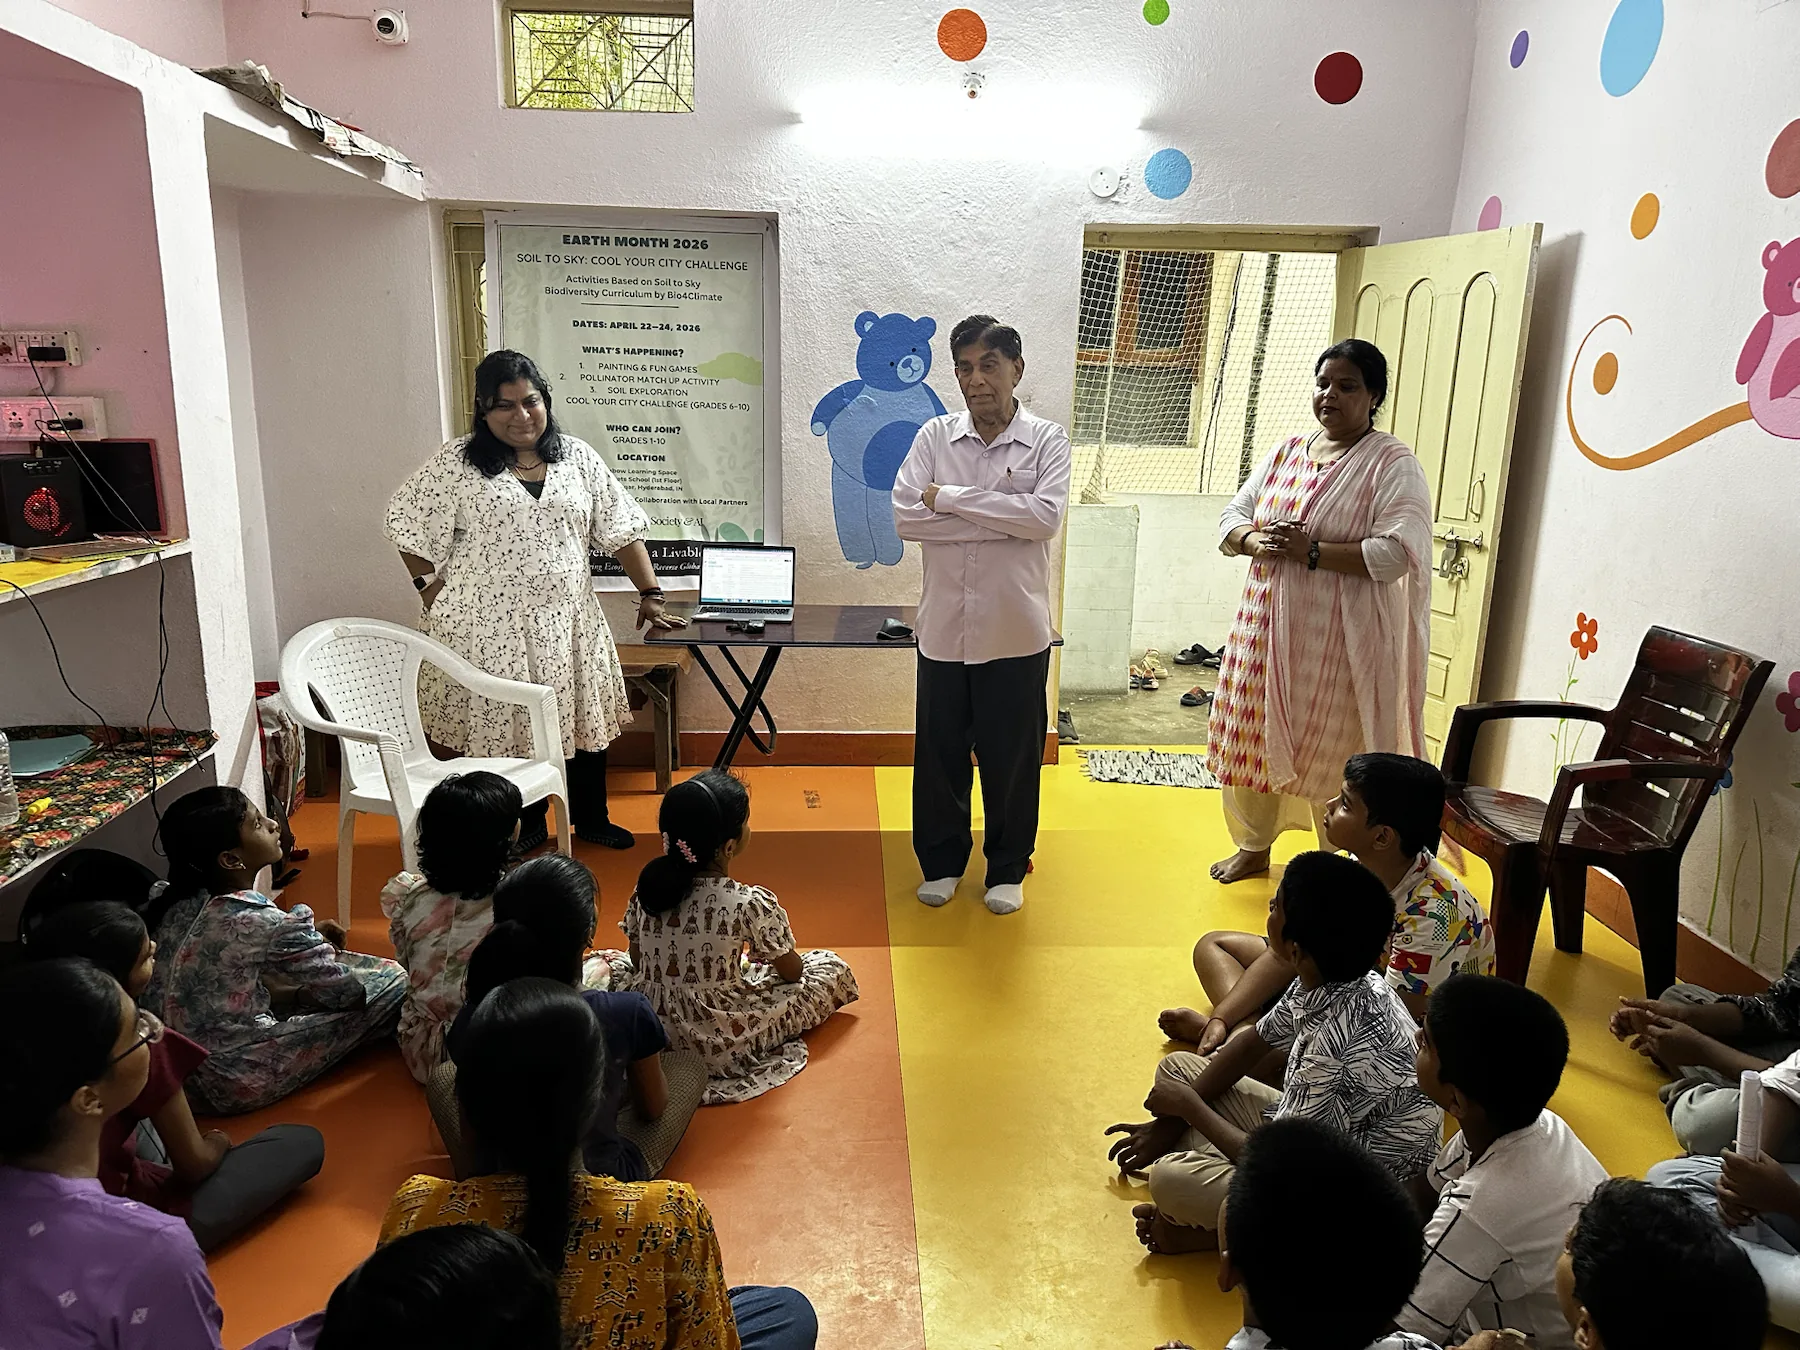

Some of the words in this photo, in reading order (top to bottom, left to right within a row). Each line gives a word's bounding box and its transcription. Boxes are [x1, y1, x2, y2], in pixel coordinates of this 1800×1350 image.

[562, 234, 610, 246] EARTH
[614, 236, 669, 248] MONTH
[673, 238, 709, 250] 2026
[516, 253, 541, 263] SOIL
[545, 254, 561, 264] TO
[563, 255, 588, 265] SKY:
[591, 256, 621, 266] COOL
[624, 257, 655, 267] YOUR
[658, 258, 682, 268] CITY
[685, 259, 748, 271] CHALLENGE
[565, 275, 609, 285] Activities
[611, 276, 639, 286] Based
[654, 278, 672, 287] Soil
[684, 279, 701, 290] Sky
[544, 286, 600, 298] Biodiversity
[601, 289, 652, 298] Curriculum
[654, 290, 665, 301] by
[667, 291, 723, 302] Bio4Climate
[572, 319, 607, 329] DATES:
[609, 321, 638, 330] APRIL
[676, 323, 701, 332] 2026
[623, 347, 684, 358] HAPPENING?
[578, 362, 585, 370] 1.
[598, 362, 639, 372] PAINTING
[640, 364, 648, 372] &
[649, 364, 667, 373] FUN
[668, 365, 698, 374] GAMES
[559, 373, 567, 381] 2.
[580, 373, 635, 384] POLLINATOR
[636, 376, 667, 385] MATCH
[668, 377, 680, 385] UP
[681, 377, 720, 387] ACTIVITY
[589, 385, 597, 394] 3.
[607, 386, 627, 395] SOIL
[629, 387, 689, 397] EXPLORATION
[565, 396, 590, 405] COOL
[592, 397, 617, 406] YOUR
[618, 398, 638, 407] CITY
[639, 399, 688, 409] CHALLENGE
[690, 400, 727, 411] (GRADES
[605, 424, 630, 432] WHO
[631, 425, 652, 433] CAN
[654, 425, 681, 435] JOIN?
[612, 436, 648, 445] GRADES
[649, 437, 666, 445] 1-10
[617, 453, 666, 462] LOCATION
[628, 468, 657, 476] Learning
[658, 469, 678, 477] Space
[663, 477, 682, 485] Floor)
[634, 496, 682, 505] Collaboration
[650, 516, 682, 527] Society
[651, 550, 659, 558] a
[679, 562, 701, 571] Globa
